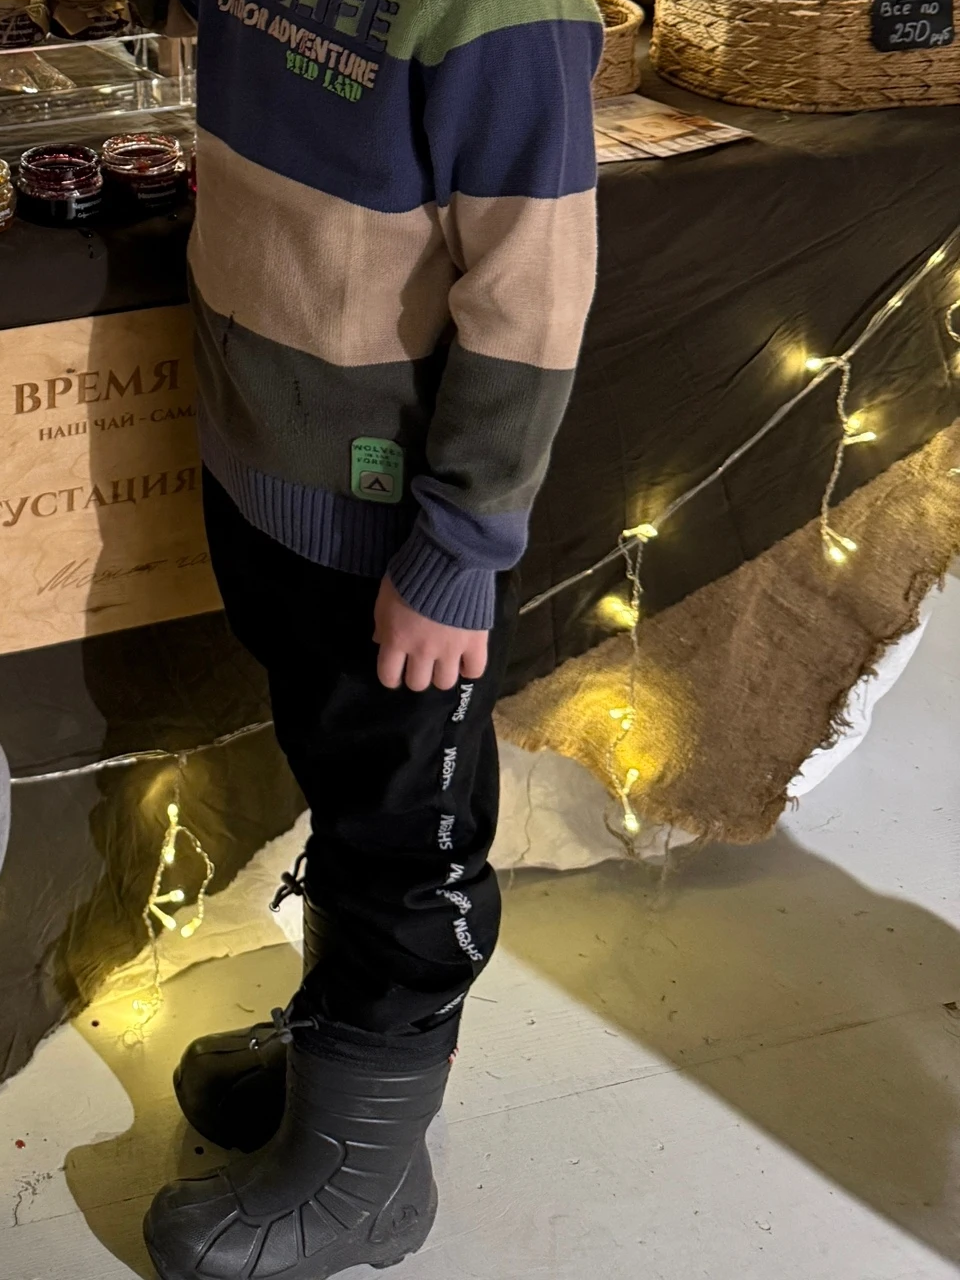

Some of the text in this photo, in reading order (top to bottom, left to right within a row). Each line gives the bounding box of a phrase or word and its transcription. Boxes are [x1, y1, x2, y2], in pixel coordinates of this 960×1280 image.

[881, 1, 940, 18] Все по
[889, 19, 931, 45] 250
[13, 359, 180, 416] ВРЕМЯ
[39, 421, 89, 442] НАШ
[93, 412, 136, 433] ЧАЙ
[150, 404, 197, 422] САМ
